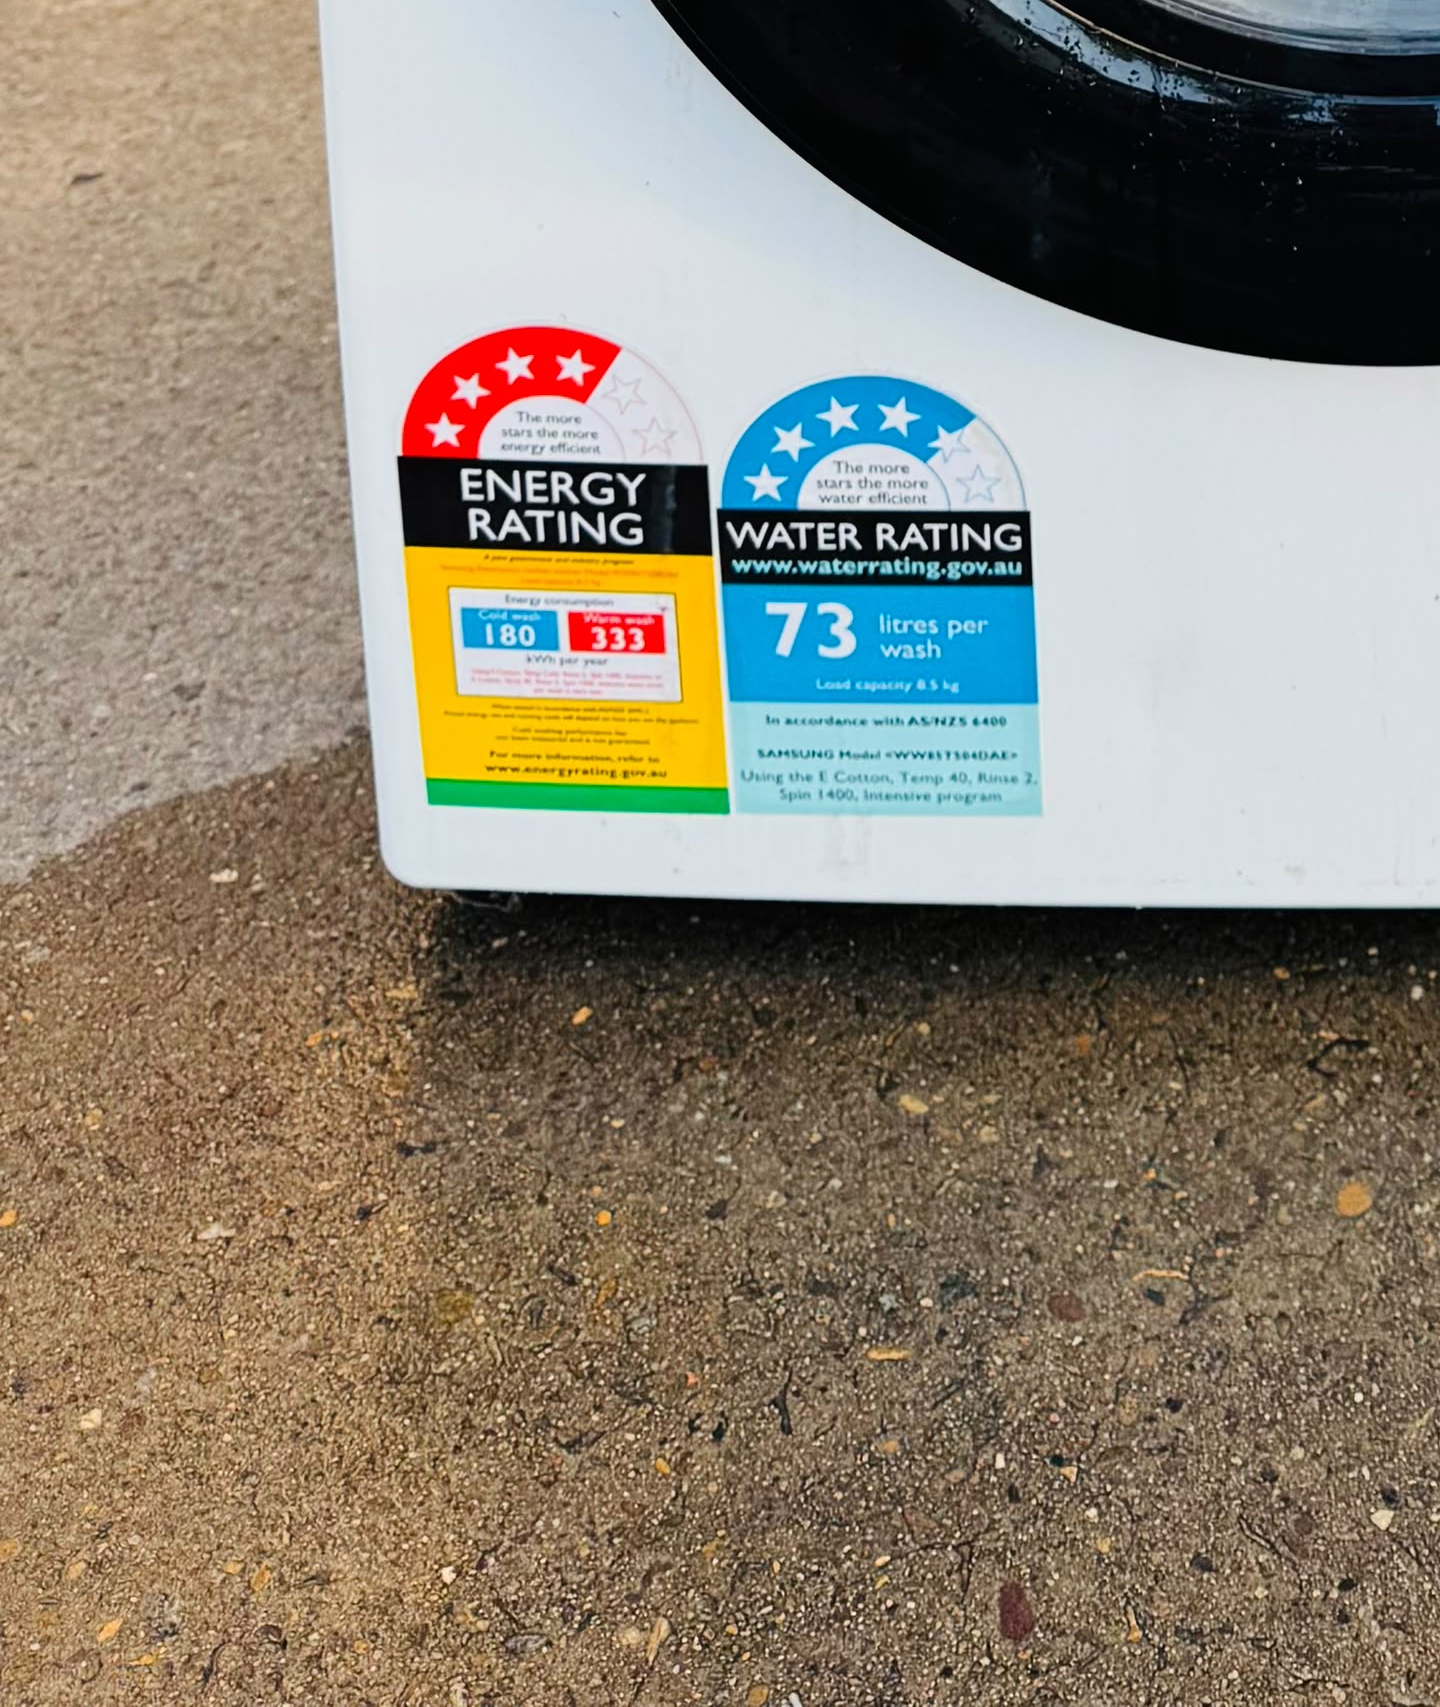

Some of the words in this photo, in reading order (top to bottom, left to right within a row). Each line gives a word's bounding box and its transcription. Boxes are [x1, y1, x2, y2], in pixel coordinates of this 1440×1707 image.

[516, 410, 544, 424] The
[546, 414, 582, 425] more
[501, 427, 533, 438] stars
[536, 427, 561, 439] the
[562, 429, 599, 440] more
[501, 442, 545, 455] energy
[549, 442, 601, 455] efficient
[833, 460, 864, 475] The
[868, 464, 910, 475] more
[460, 467, 647, 507] ENERGY
[816, 478, 853, 489] stars
[857, 477, 883, 489] the
[886, 480, 929, 490] more
[819, 493, 862, 505] water
[867, 491, 928, 505] efficient
[467, 507, 645, 547] RATING
[725, 521, 862, 552] WATER
[875, 522, 1023, 553] RATING
[731, 556, 1023, 581] www.waterrating.gov.au
[505, 594, 541, 607] Energy
[544, 596, 615, 608] consumption
[478, 608, 509, 621] Cold
[512, 610, 541, 621] wash
[582, 612, 621, 624] Warm
[624, 614, 655, 625] wash
[765, 601, 858, 659] 73
[878, 613, 939, 634] litres
[948, 619, 989, 640] per
[485, 622, 536, 647] 180
[590, 627, 646, 651] 333
[880, 639, 942, 659] wash
[526, 653, 556, 664] kWh
[559, 657, 579, 668] per
[583, 657, 609, 668] year
[815, 678, 850, 691] Load
[855, 679, 912, 693] capacity
[942, 680, 960, 693] kg
[765, 714, 780, 726] In
[784, 715, 869, 727] accordance
[872, 715, 904, 727] with
[907, 716, 967, 727] AS/NZS
[757, 748, 834, 760] SAMSUNG
[839, 749, 881, 761] Model
[740, 769, 784, 785] Using
[788, 770, 813, 783] the
[833, 770, 895, 786] Cotton,
[899, 772, 944, 787] Temp
[977, 772, 1020, 785] Rinse
[779, 788, 811, 803] Spin
[863, 789, 932, 802] Intensive
[937, 792, 1002, 805] program
